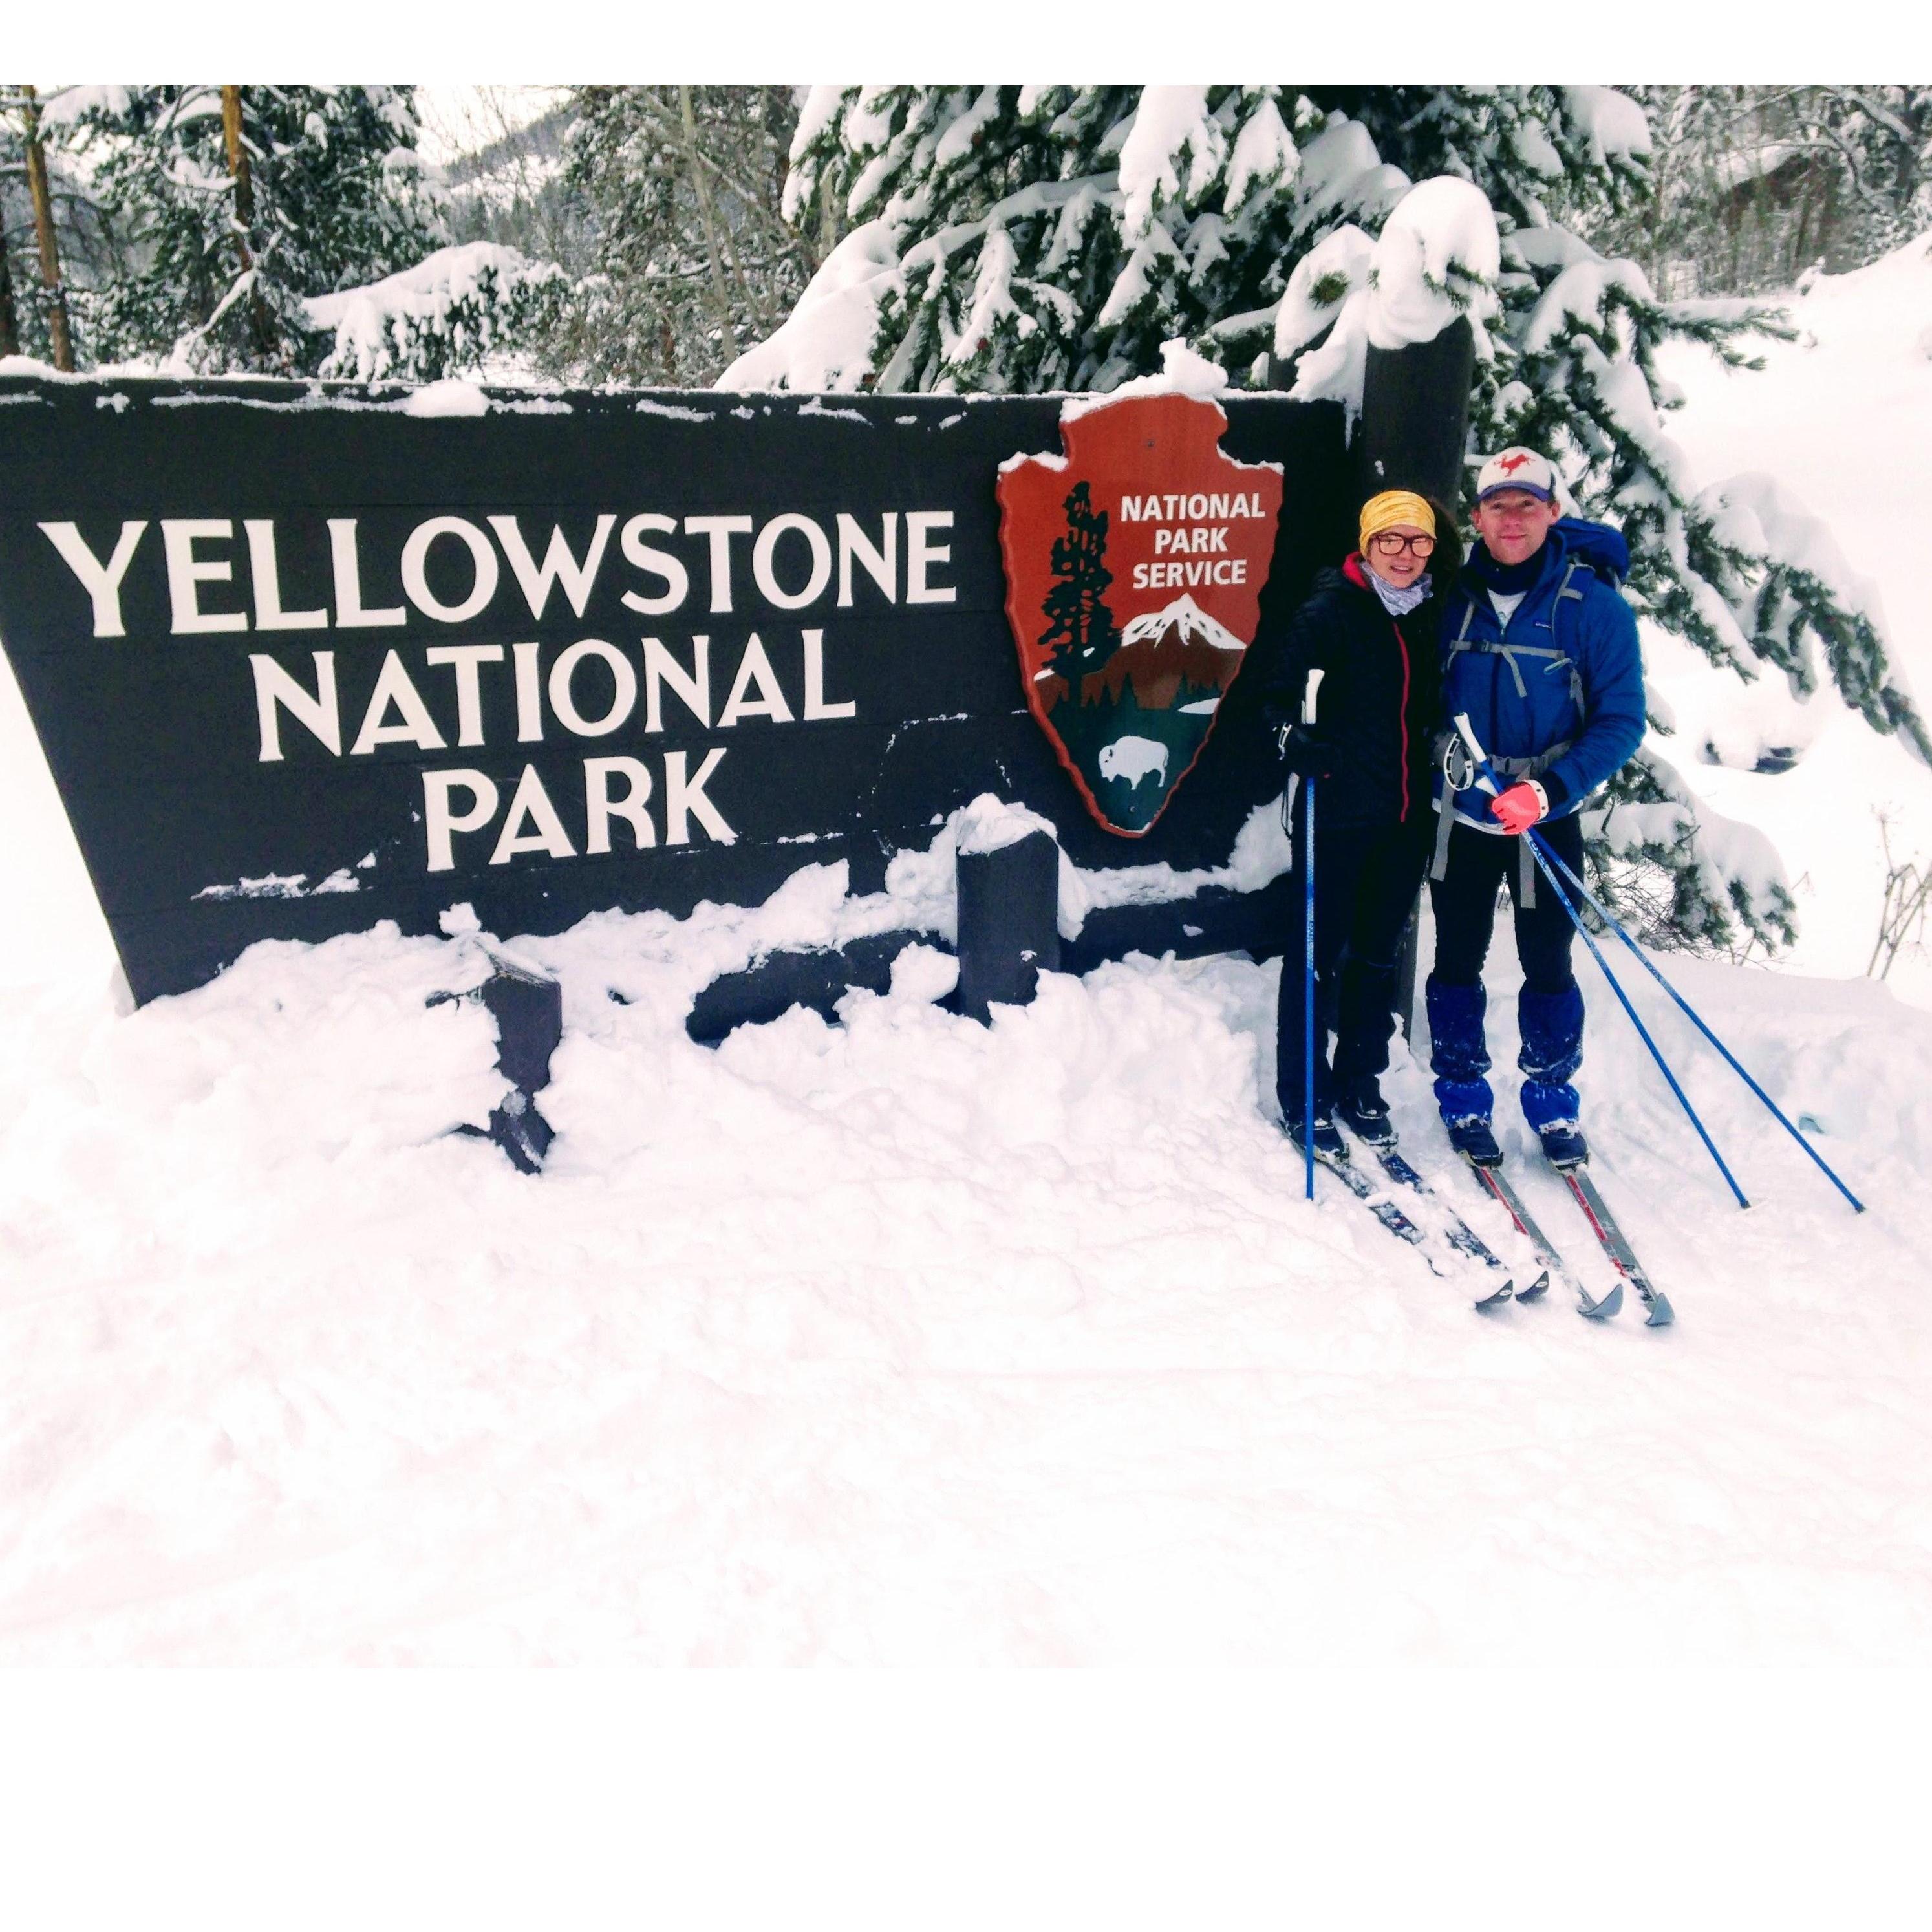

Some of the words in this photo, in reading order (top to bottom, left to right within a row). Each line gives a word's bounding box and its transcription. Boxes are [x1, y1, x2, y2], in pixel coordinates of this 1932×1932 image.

[1121, 493, 1265, 522] NATIONAL
[1155, 527, 1229, 554] PARK
[37, 511, 957, 638] YELLOWSTONE
[1133, 559, 1247, 589] SERVICE
[248, 629, 855, 762] NATIONAL
[422, 747, 738, 872] PARK
